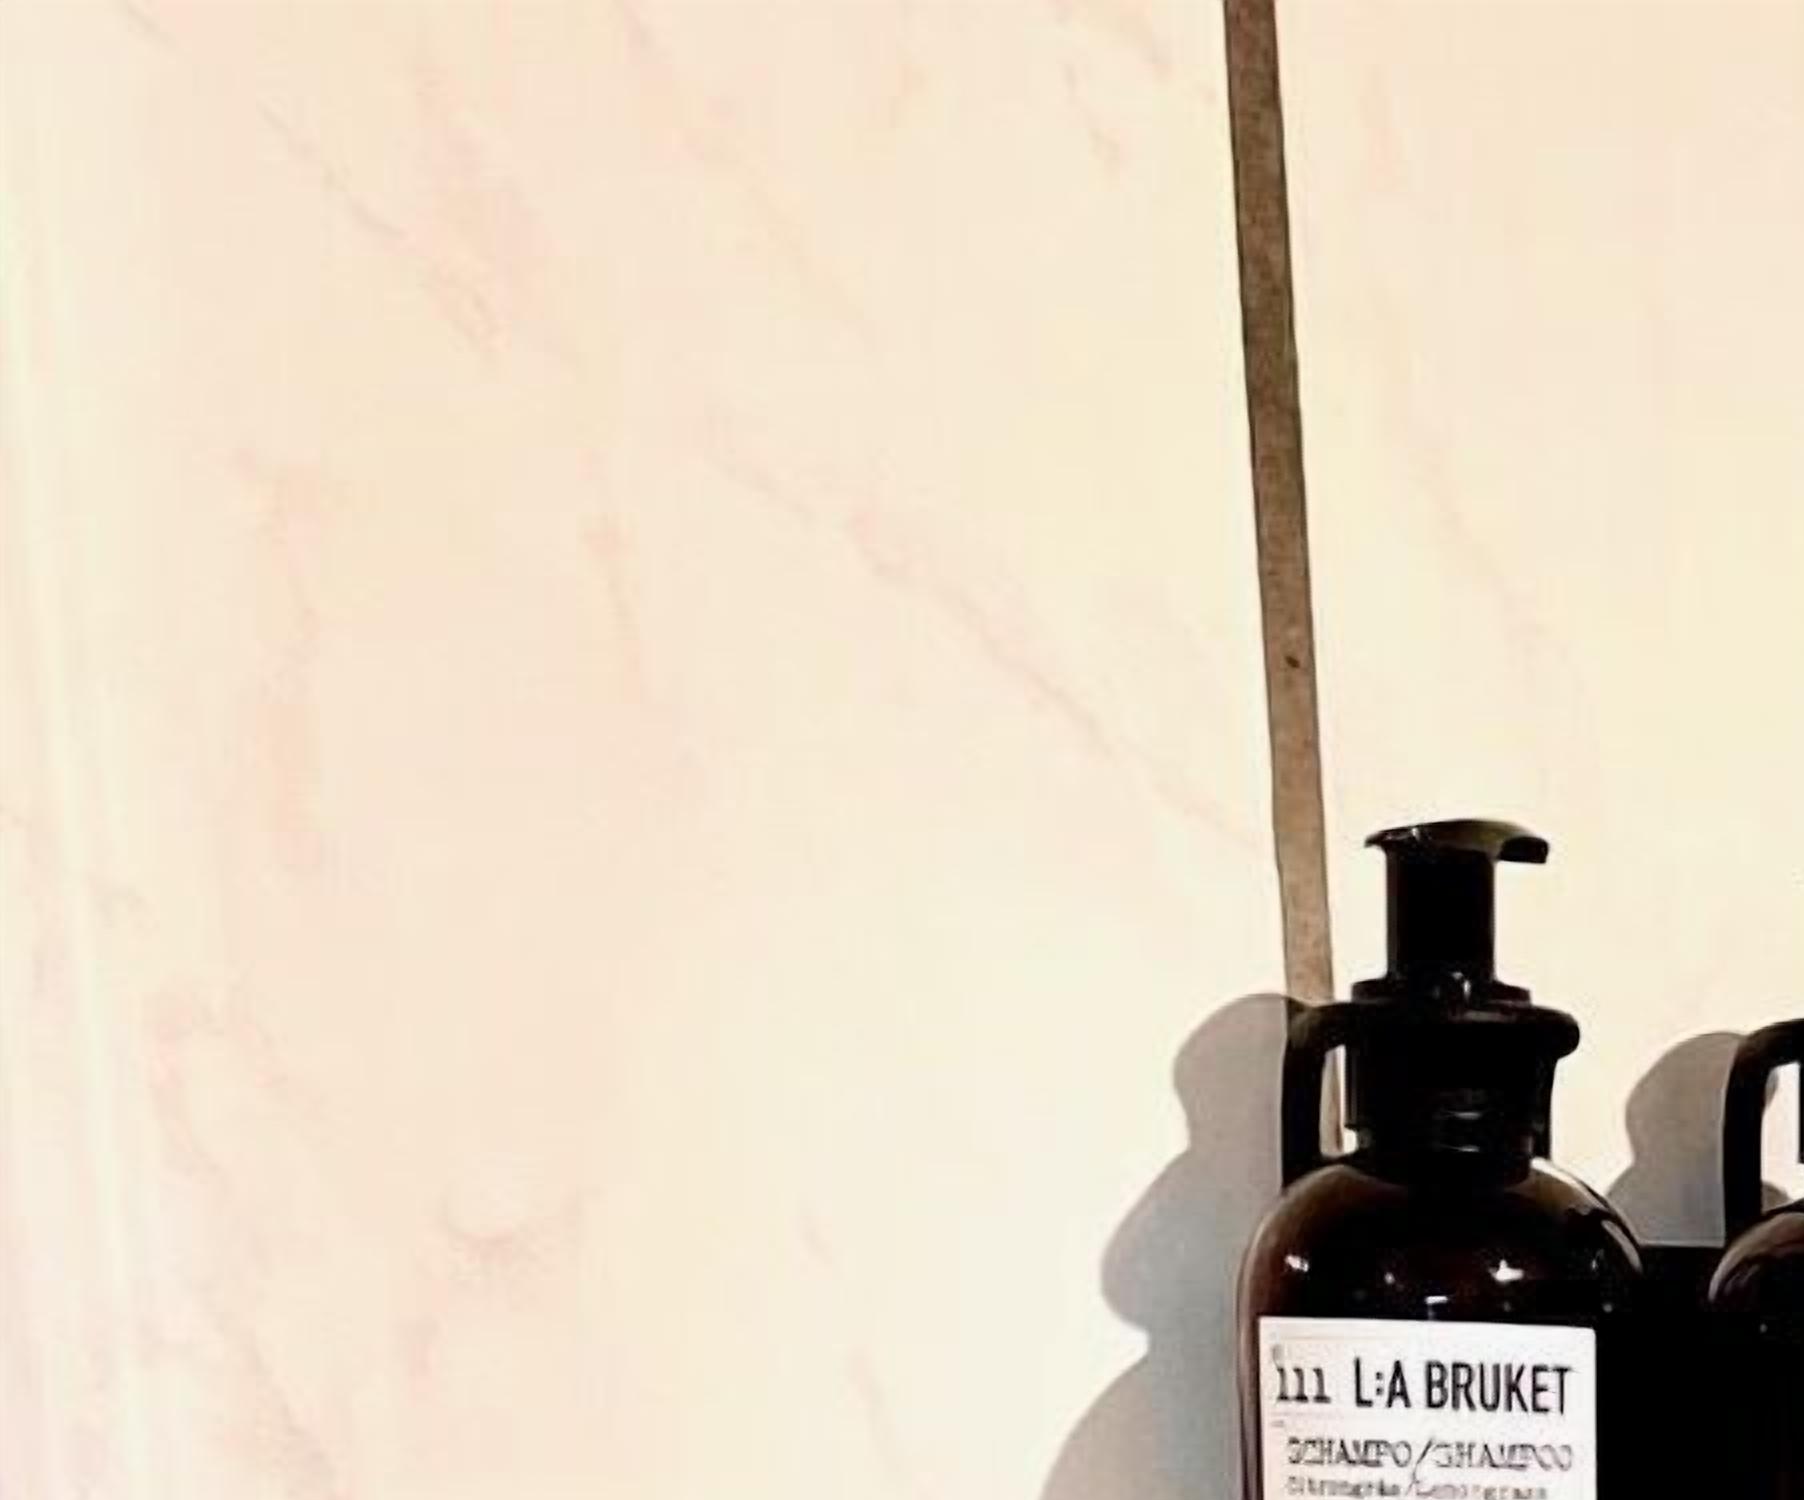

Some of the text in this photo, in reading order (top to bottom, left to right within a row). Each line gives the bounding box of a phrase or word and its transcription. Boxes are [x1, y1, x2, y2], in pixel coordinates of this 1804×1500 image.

[1275, 1356, 1574, 1416] 111 L:A BRUKET
